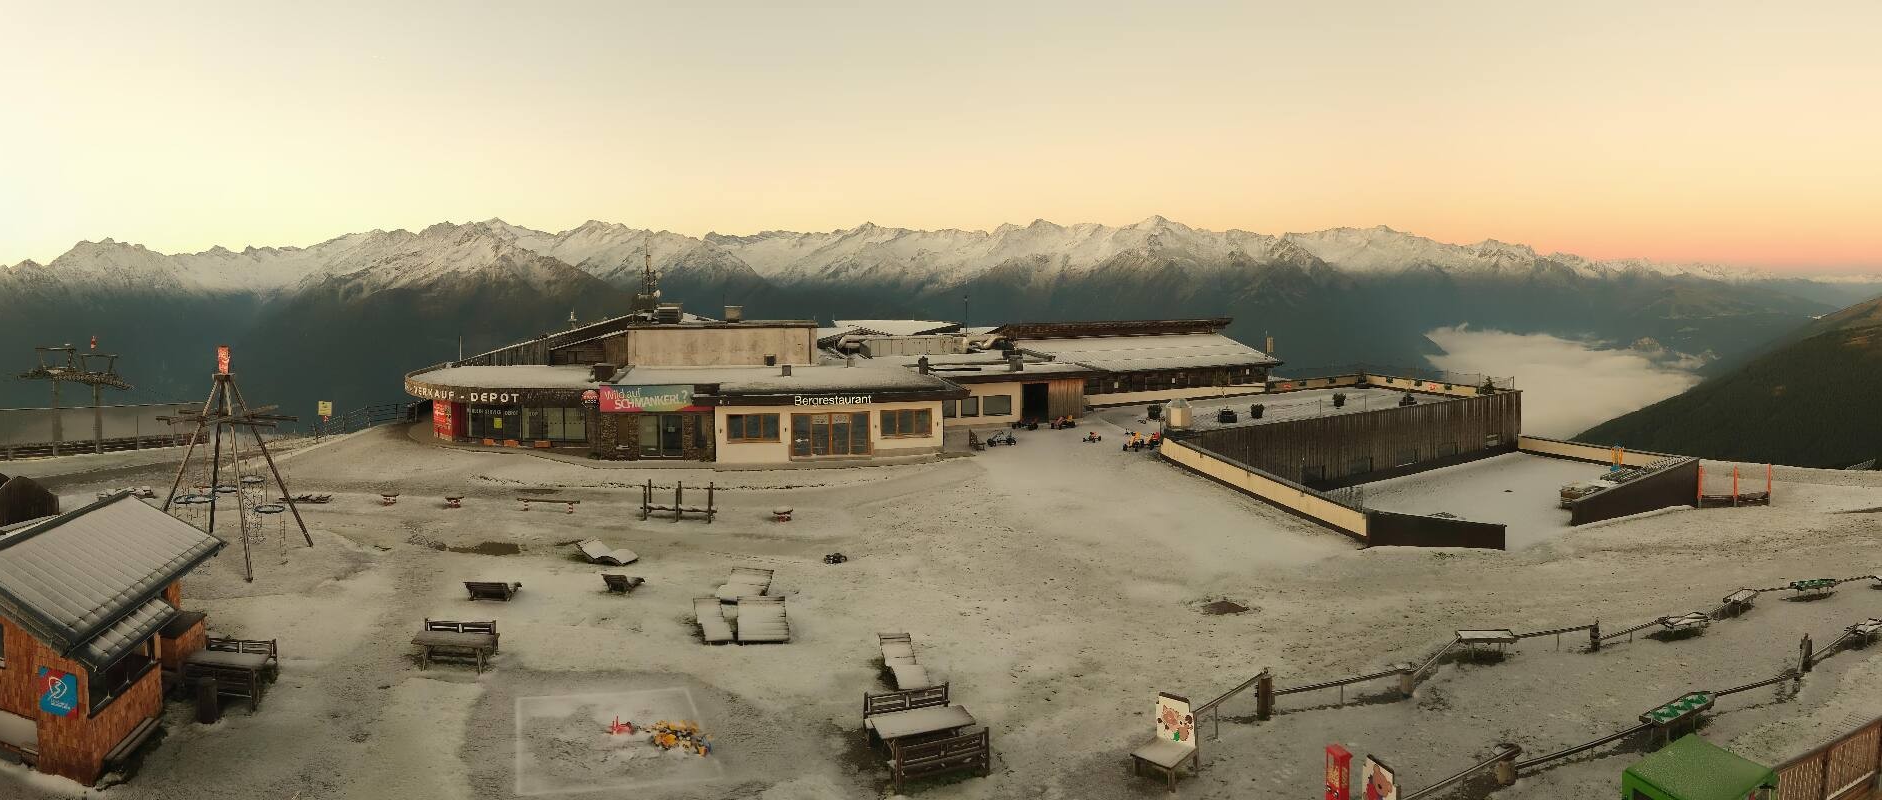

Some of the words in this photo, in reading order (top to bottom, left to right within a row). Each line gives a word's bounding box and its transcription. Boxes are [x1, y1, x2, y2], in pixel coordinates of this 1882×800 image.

[414, 385, 455, 400] VERKAUF
[470, 392, 520, 403] DEPOT
[604, 388, 625, 400] Wild
[626, 387, 642, 398] auf
[794, 394, 872, 407] Bergrestaurant
